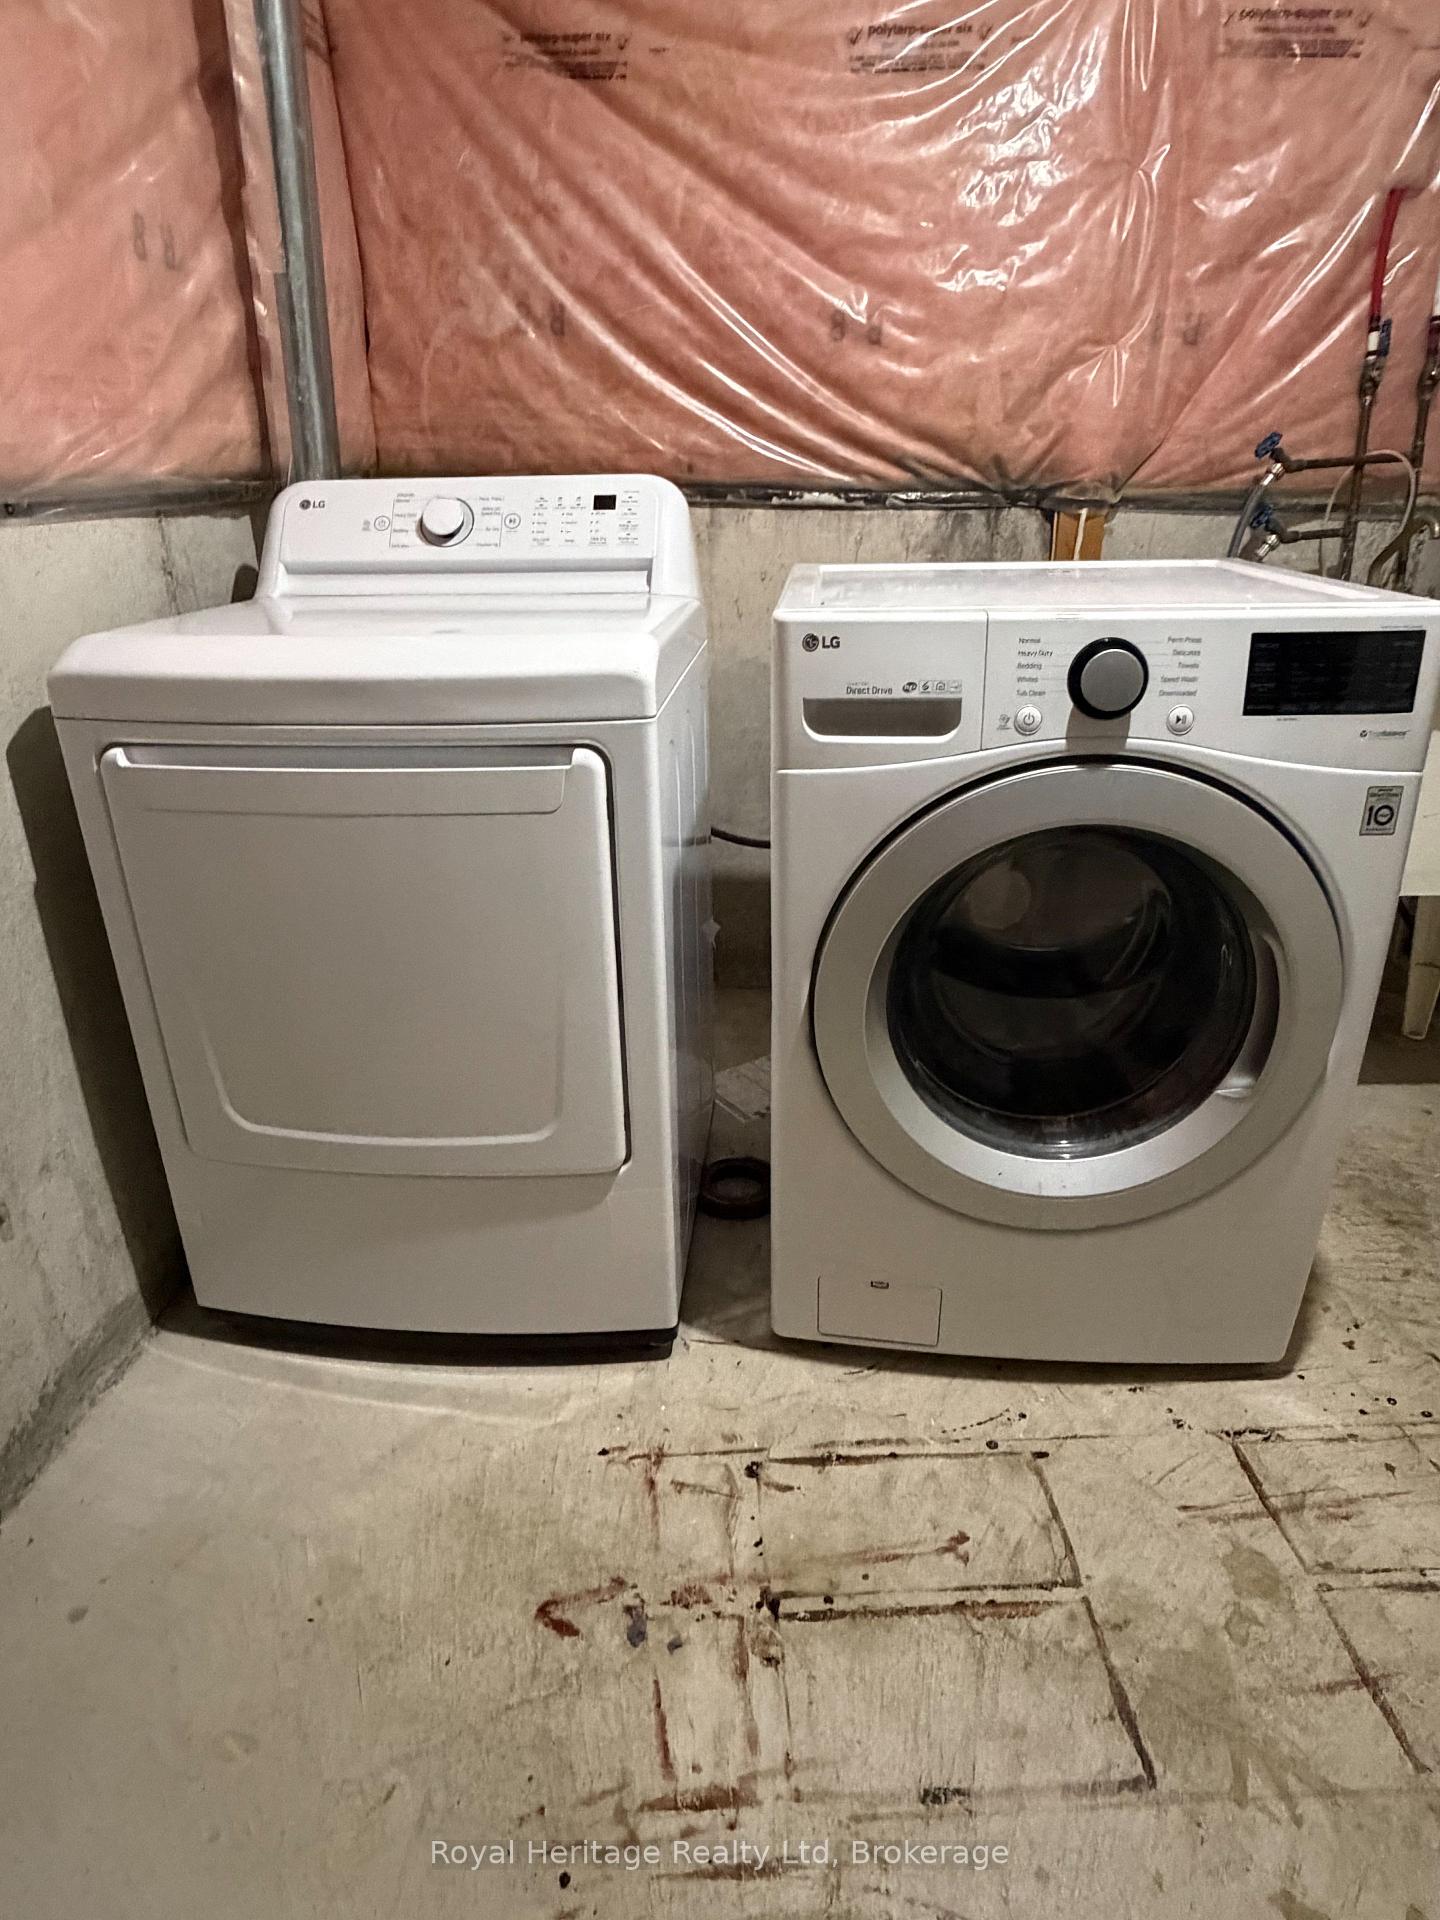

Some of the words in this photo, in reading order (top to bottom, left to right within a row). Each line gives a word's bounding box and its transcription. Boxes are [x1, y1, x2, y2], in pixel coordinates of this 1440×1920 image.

[867, 22, 952, 40] polytarp-ser
[955, 22, 972, 34] six
[312, 500, 326, 509] LG
[822, 636, 841, 649] LG
[846, 685, 870, 695] Direct
[871, 685, 893, 695] Drive
[1366, 803, 1395, 827] 10
